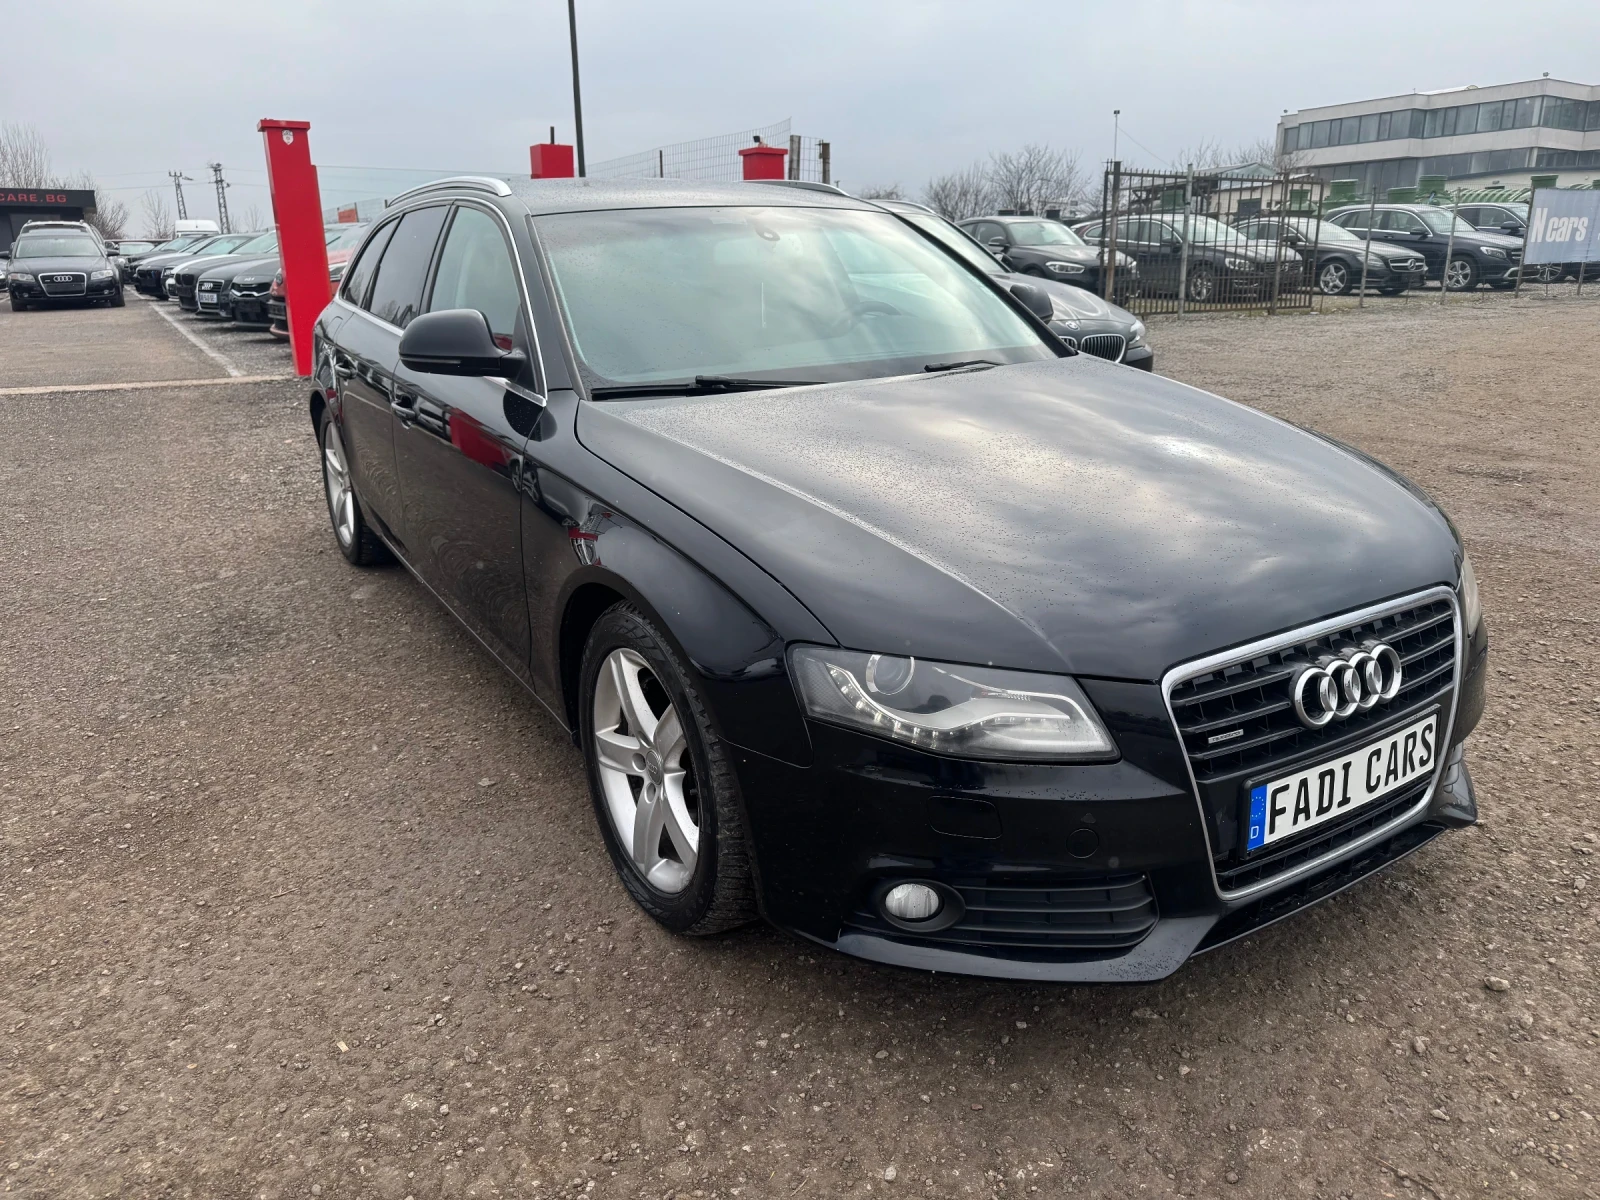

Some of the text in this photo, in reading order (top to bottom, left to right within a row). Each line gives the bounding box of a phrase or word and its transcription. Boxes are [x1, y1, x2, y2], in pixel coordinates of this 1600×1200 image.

[1269, 723, 1433, 835] FADI CARS
[1250, 825, 1259, 839] D
